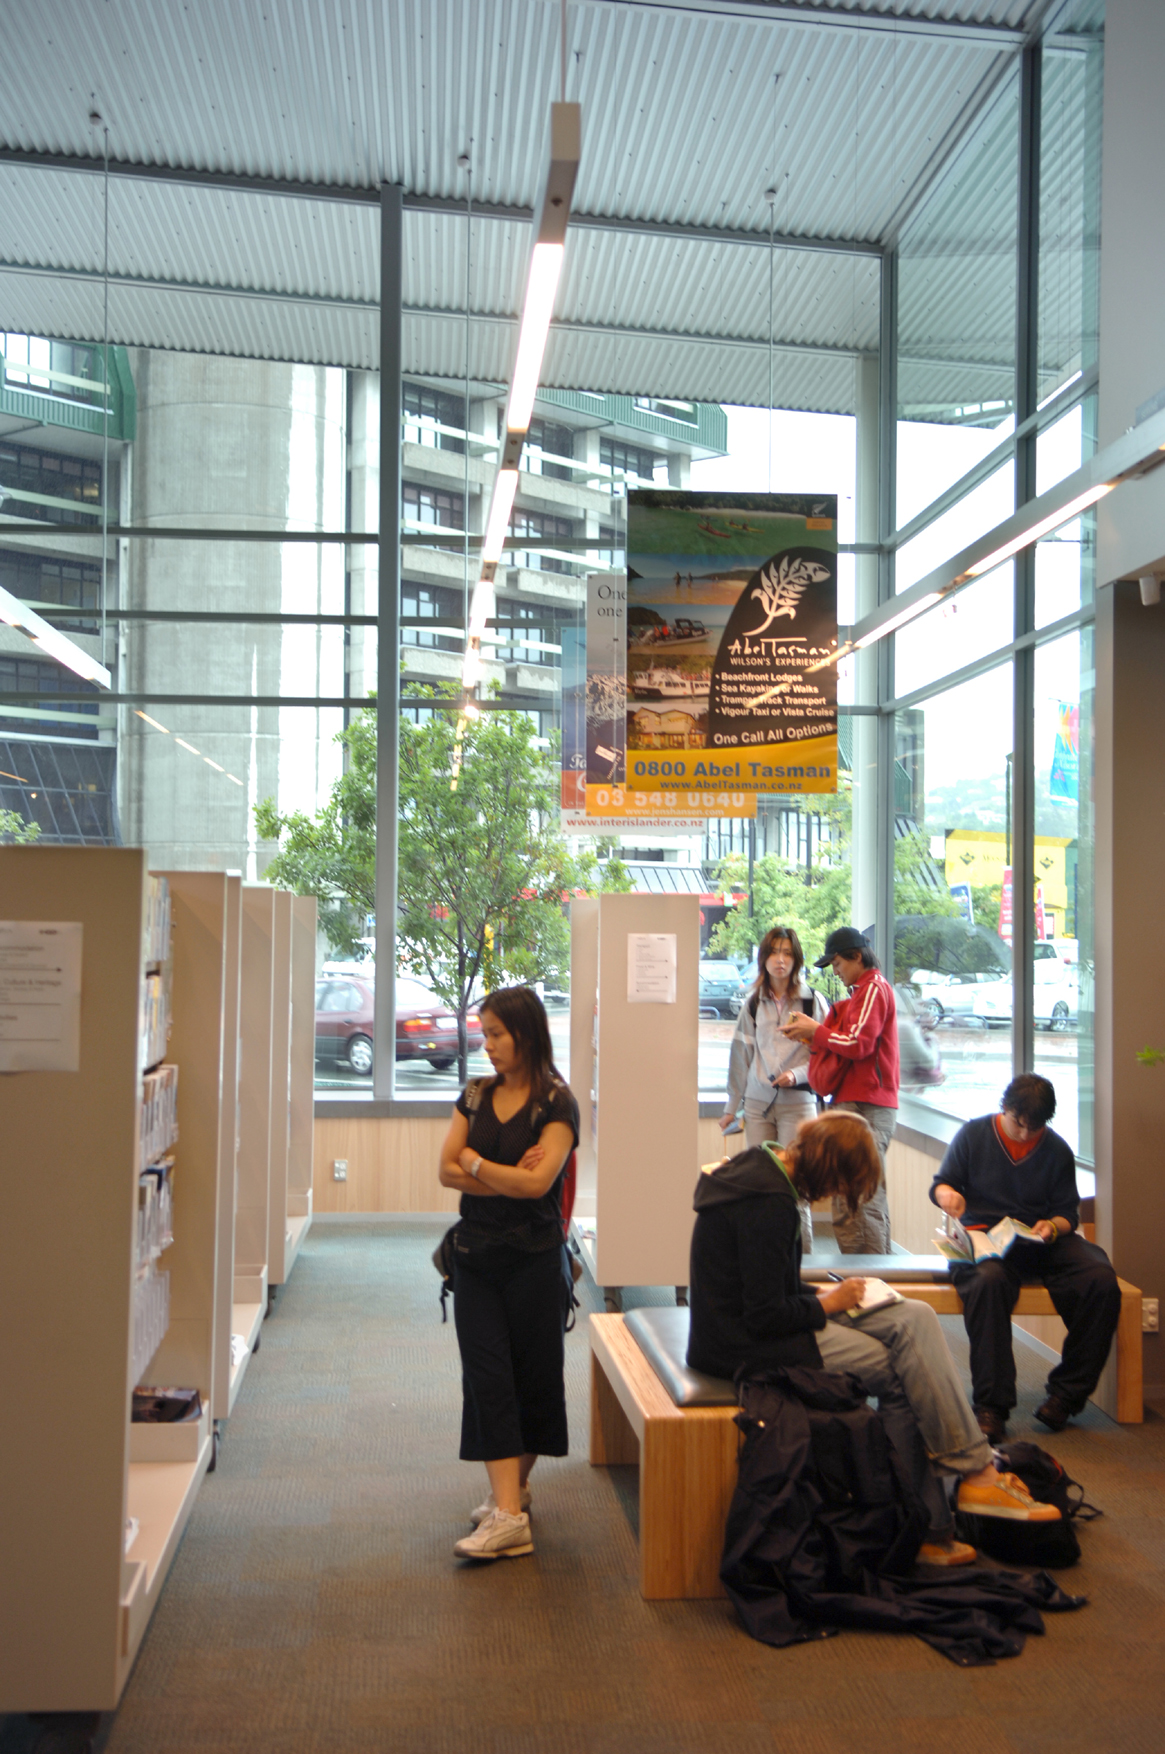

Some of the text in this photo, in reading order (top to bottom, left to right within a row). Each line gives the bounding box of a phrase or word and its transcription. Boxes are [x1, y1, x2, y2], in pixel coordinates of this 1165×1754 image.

[597, 607, 623, 617] one
[727, 637, 765, 656] Abel
[730, 657, 772, 667] WILSON'S
[721, 671, 804, 684] Beachfront Lodges
[721, 683, 739, 693] Sea
[740, 684, 780, 694] Kayakin
[792, 685, 820, 694] Walks
[784, 696, 827, 707] Transport
[721, 707, 750, 718] Vigour
[752, 708, 770, 717] Taxi
[782, 708, 805, 717] Vista
[806, 708, 835, 717] Cruise
[713, 723, 834, 745] One Call All Options
[634, 761, 687, 777] 0800
[693, 761, 740, 777] Abel
[748, 762, 831, 778] Tasman
[660, 780, 803, 790] www.AbelTasman.co.nz
[596, 788, 745, 808] 03 548 0640
[625, 806, 725, 817] www.jenshansen.com
[566, 816, 704, 828] www.interislander.co.nz
